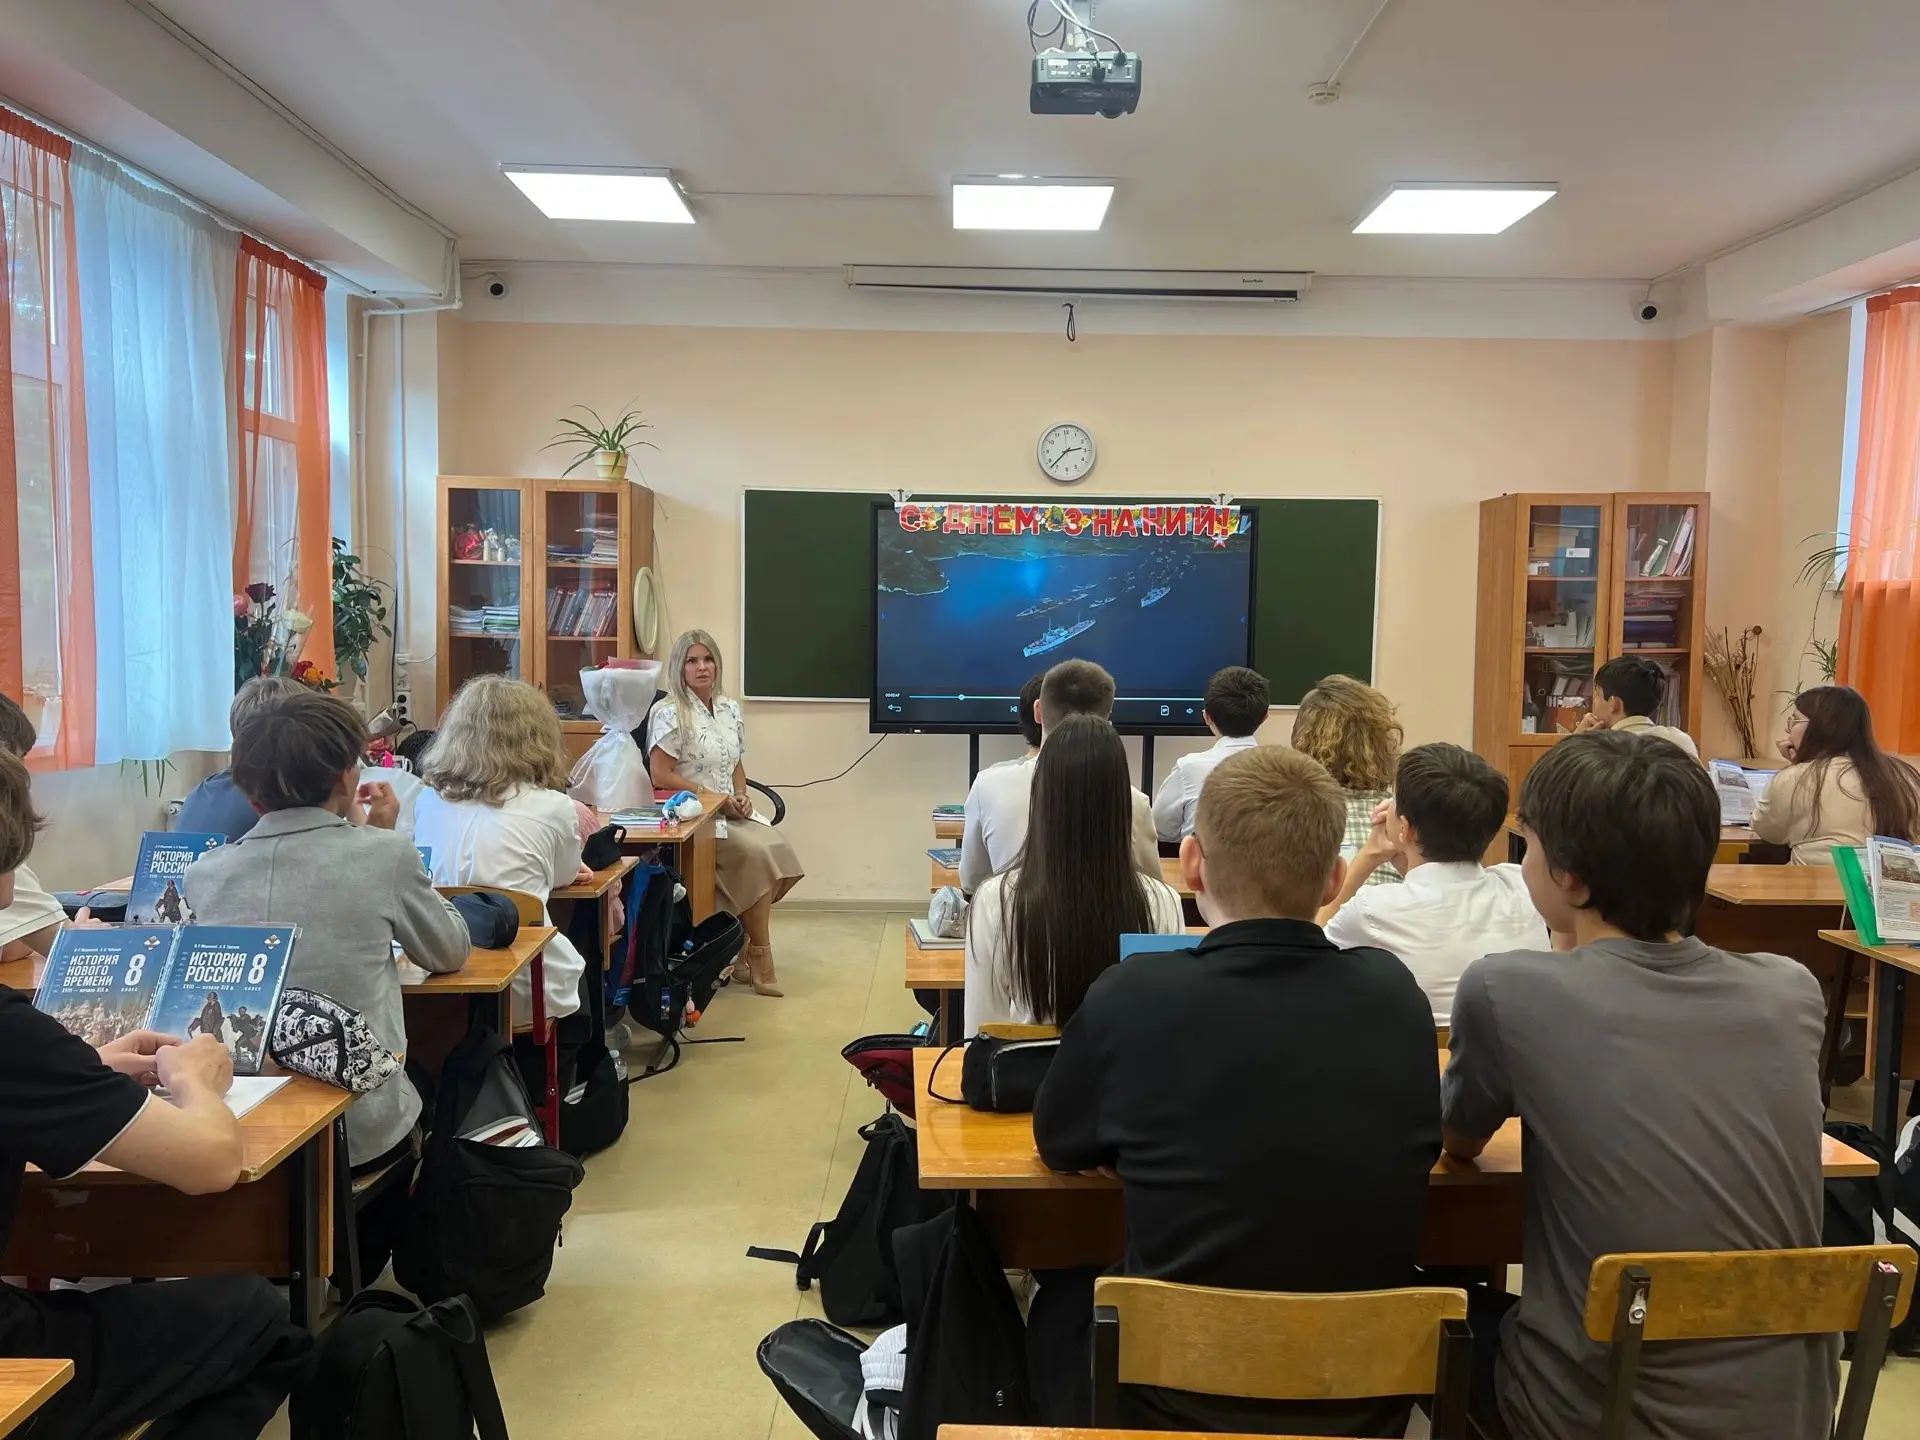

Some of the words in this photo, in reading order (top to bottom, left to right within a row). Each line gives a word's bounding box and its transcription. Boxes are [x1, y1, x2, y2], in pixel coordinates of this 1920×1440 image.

[900, 504, 922, 532] С
[943, 504, 1040, 535] ДНЁМ
[1064, 505, 1231, 537] ЗНАНИЙ!
[152, 851, 193, 862] ИСТОРИЯ
[69, 954, 120, 966] ИСТОРИЯ
[189, 952, 247, 967] ИСТОРИЯ
[66, 965, 109, 976] НОВОГО
[124, 953, 146, 986] 8
[184, 966, 243, 983] РОССИИ
[247, 953, 268, 985] 8
[63, 976, 114, 987] ВРЕМЕНИ
